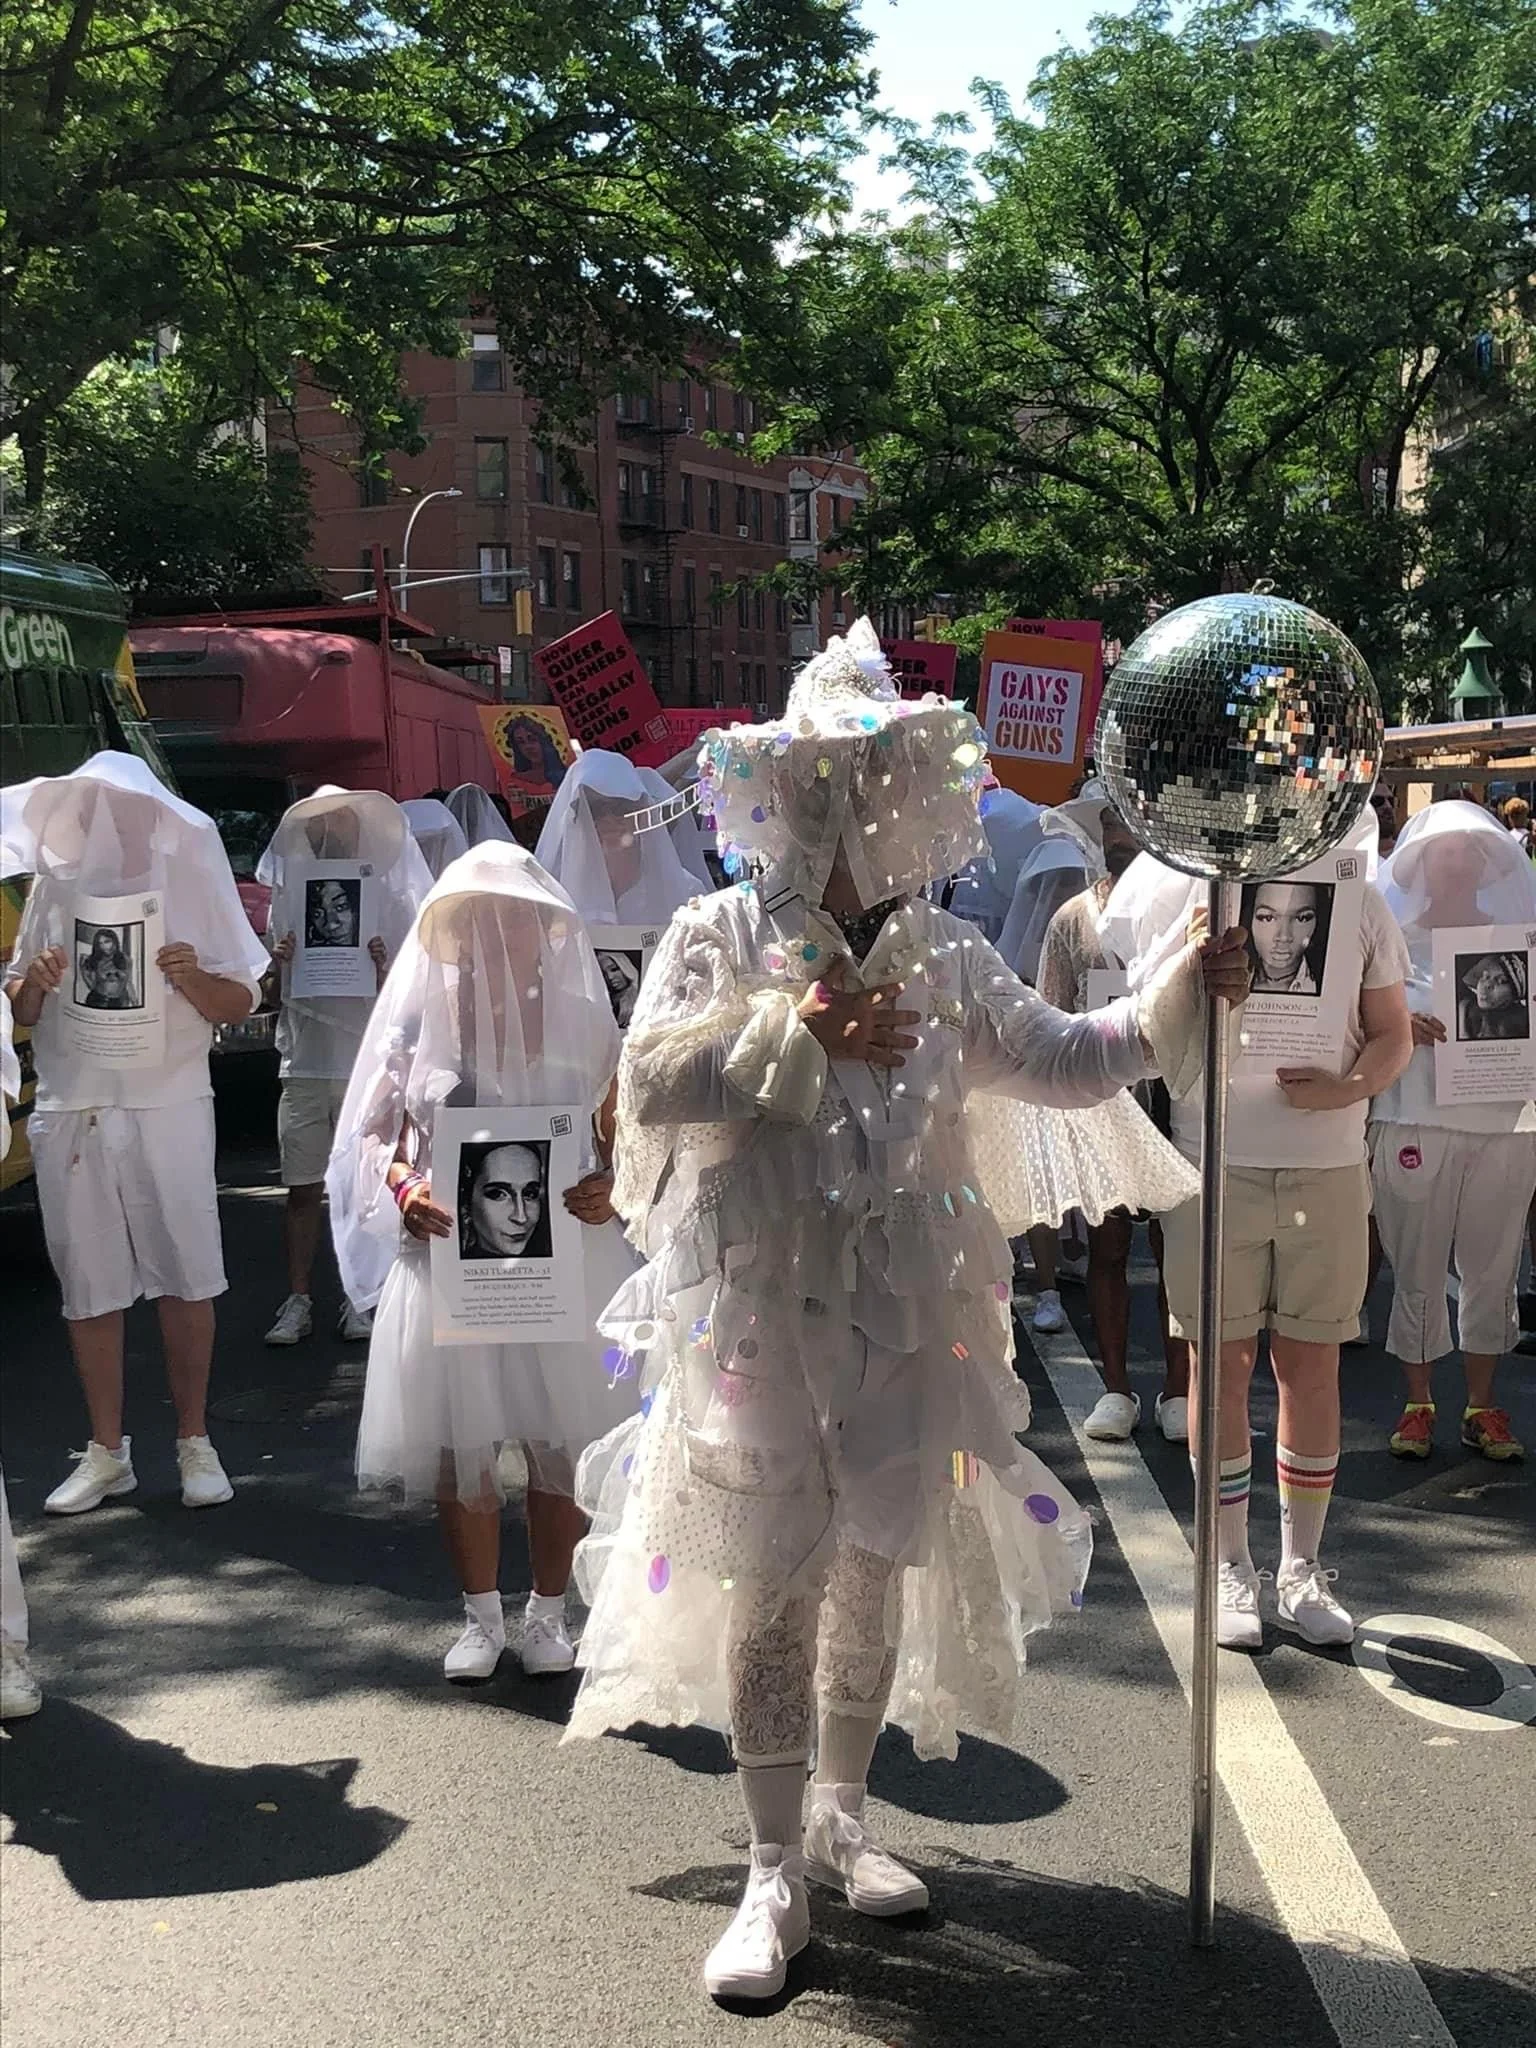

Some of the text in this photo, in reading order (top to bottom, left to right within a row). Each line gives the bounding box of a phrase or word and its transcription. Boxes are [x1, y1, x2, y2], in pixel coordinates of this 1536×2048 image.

[1, 606, 78, 672] Green
[1012, 623, 1046, 635] HOW
[541, 641, 571, 665] HOW
[548, 639, 605, 679] QUEER
[554, 645, 627, 693] BASHERS
[561, 685, 586, 704] CAN
[567, 669, 636, 719] LEGALLY
[1000, 670, 1069, 705] GAYS
[575, 701, 612, 729] CARRY
[580, 706, 630, 742] GUNS
[998, 701, 1065, 725] AGAINST
[995, 720, 1064, 755] GUNS
